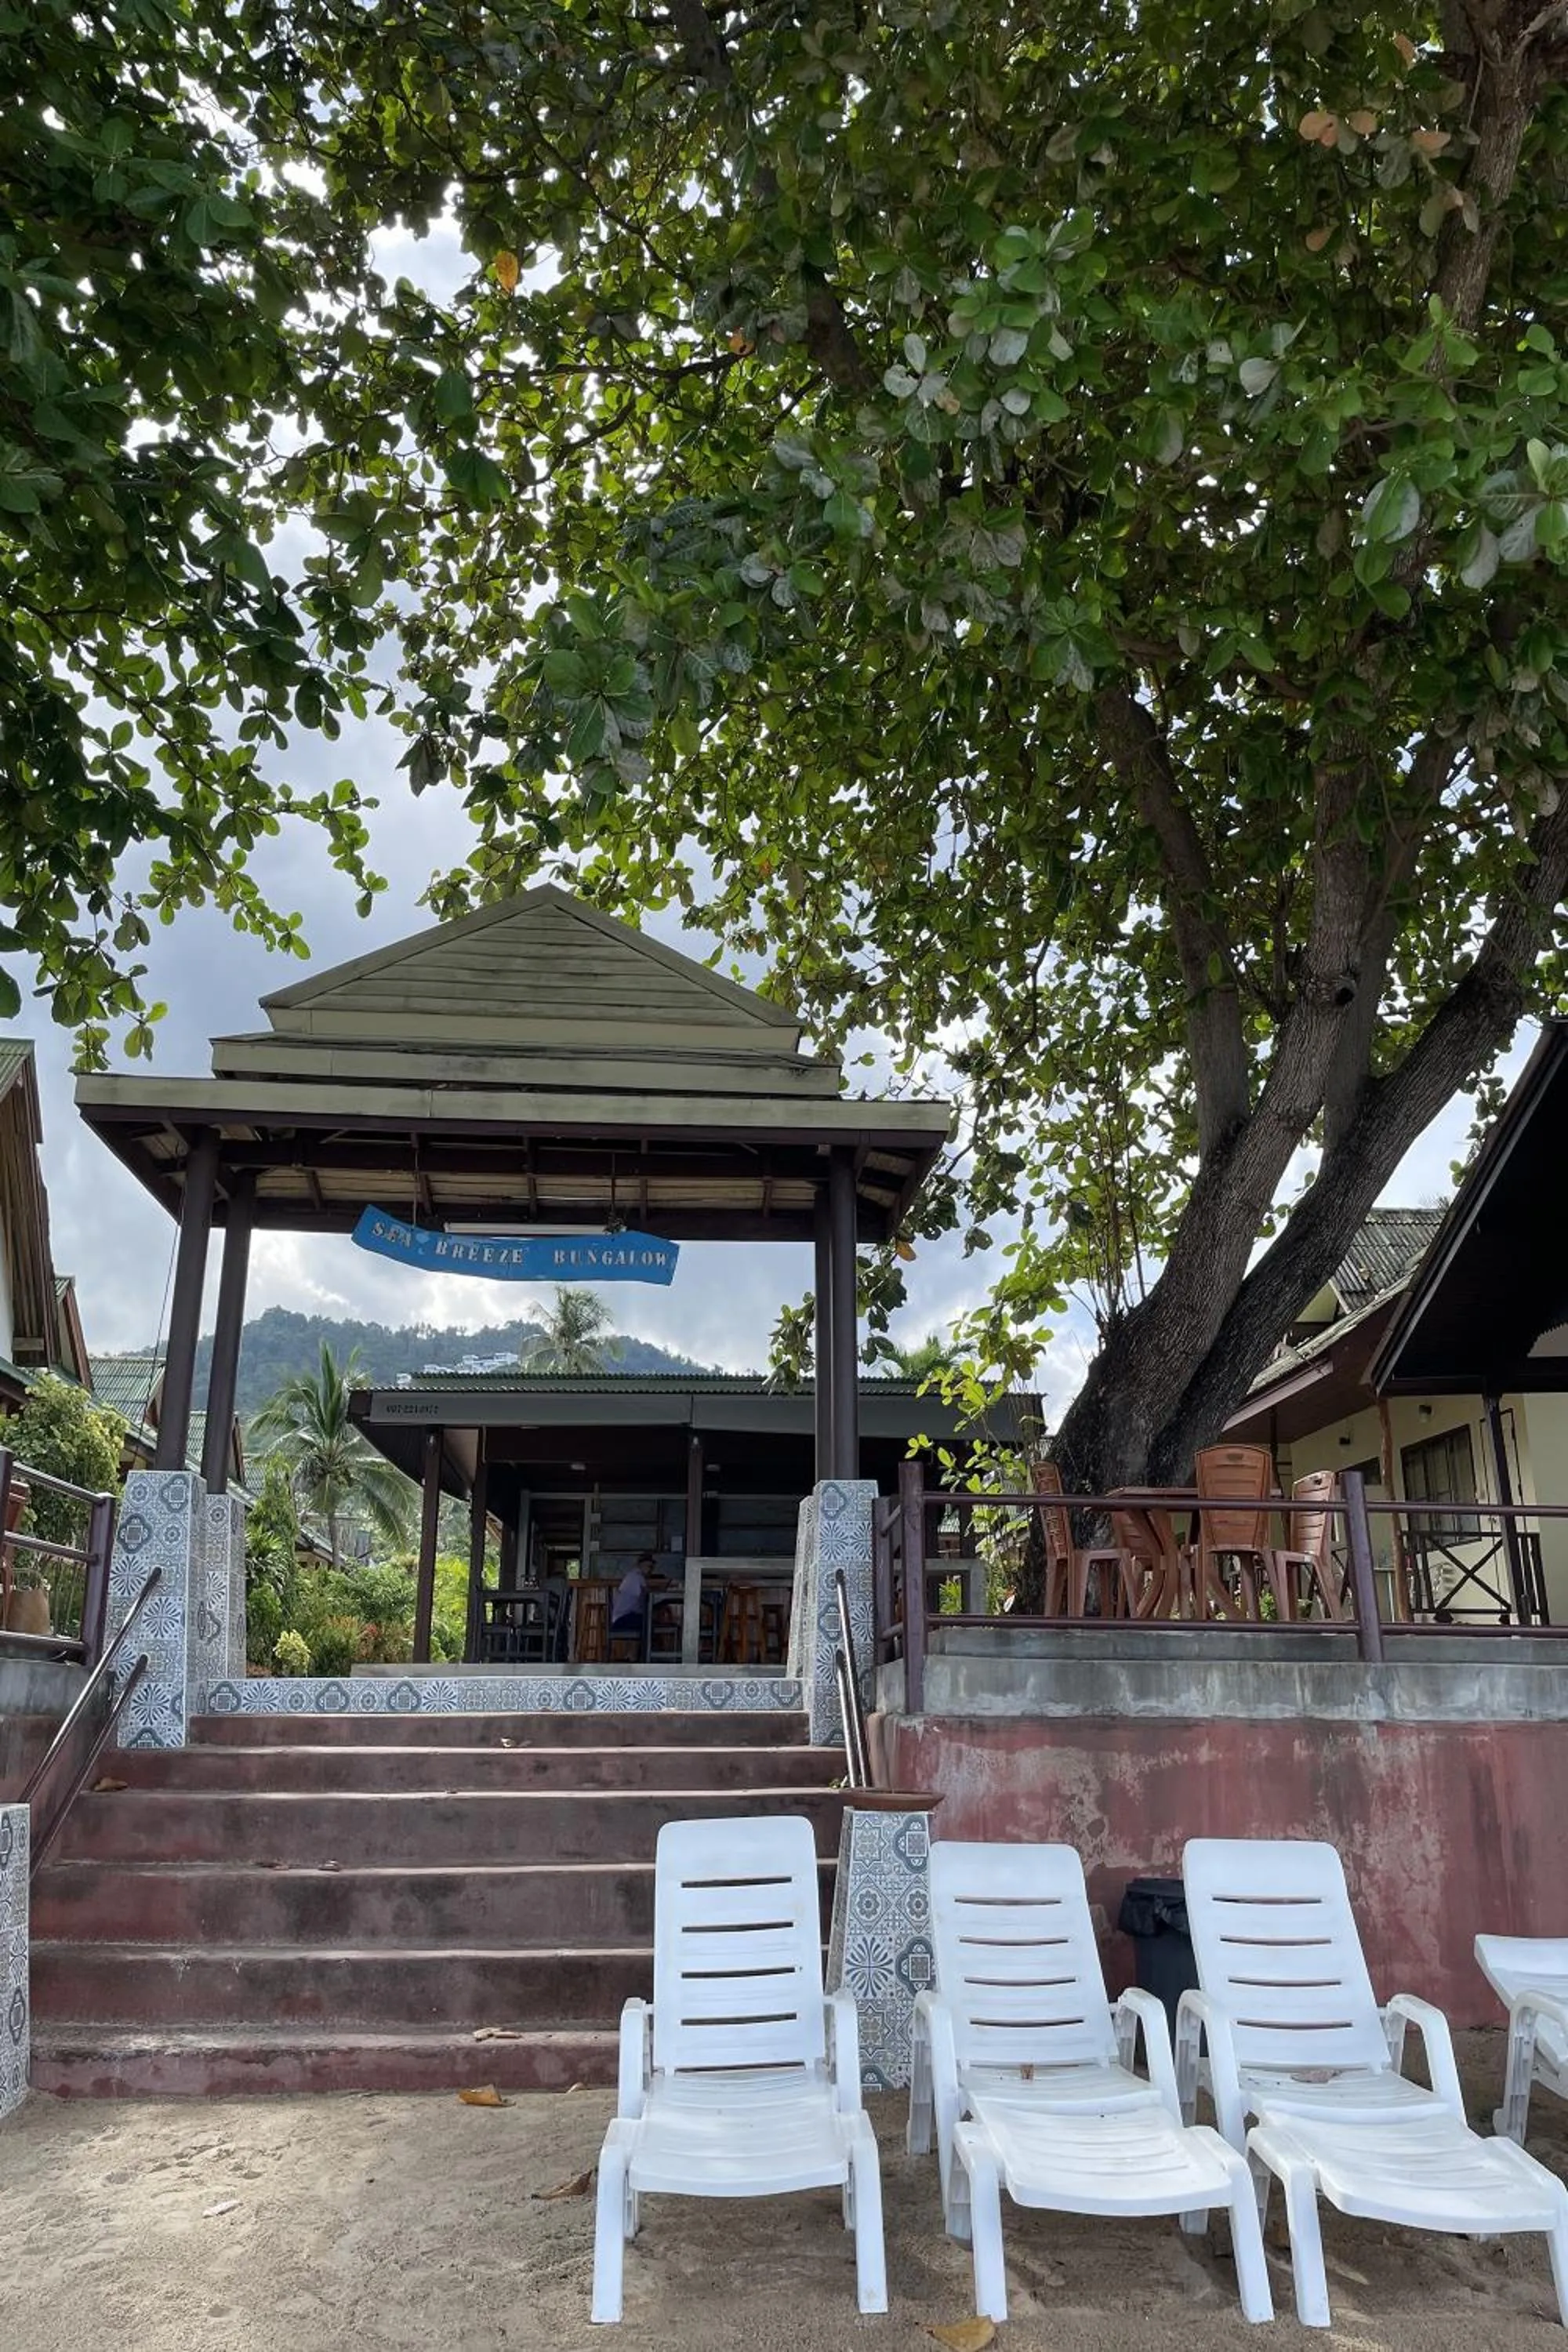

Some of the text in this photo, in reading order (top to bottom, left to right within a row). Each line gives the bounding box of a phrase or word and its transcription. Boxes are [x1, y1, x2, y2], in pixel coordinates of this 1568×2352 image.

[372, 1221, 668, 1266] SEA BREEZE BUNGALOW
